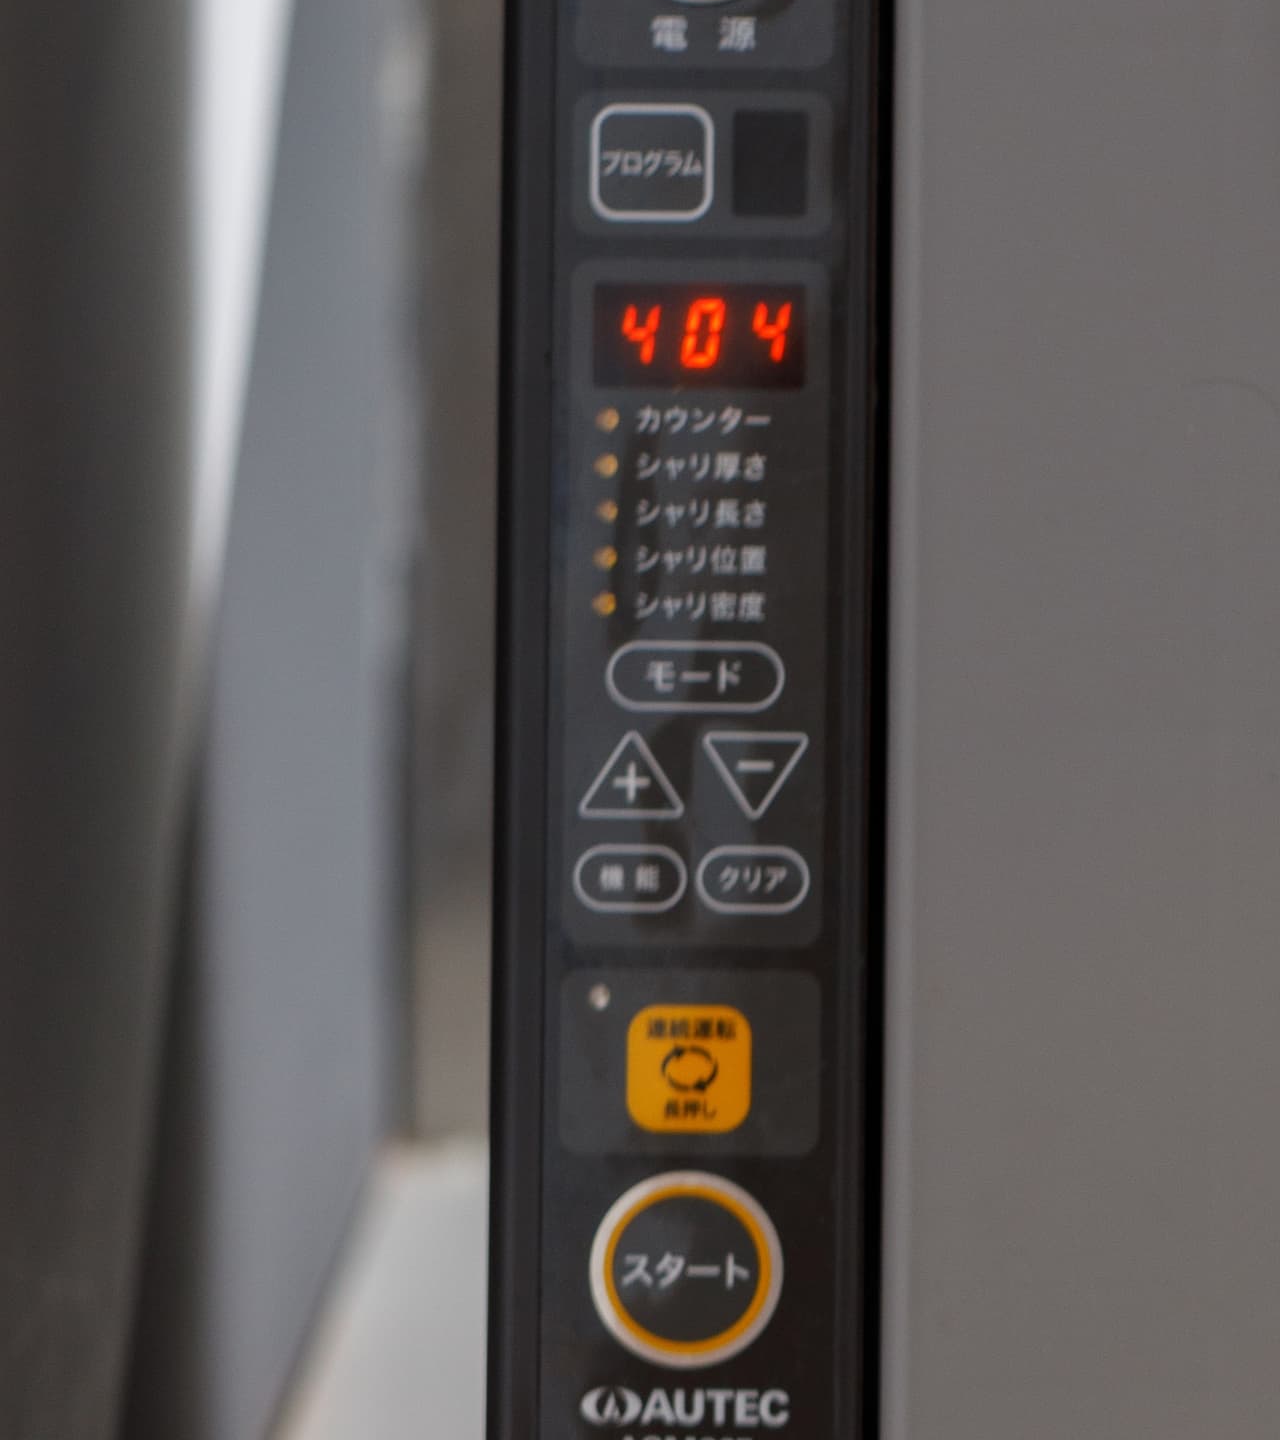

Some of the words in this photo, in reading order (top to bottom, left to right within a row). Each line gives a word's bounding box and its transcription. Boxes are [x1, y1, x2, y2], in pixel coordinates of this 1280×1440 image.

[601, 149, 703, 178] プログラム
[621, 297, 793, 369] 404
[636, 404, 772, 434] カウンター
[647, 658, 743, 693] モード
[718, 865, 788, 893] クリア
[620, 1251, 751, 1290] スタート
[640, 1388, 791, 1428] AUTEC
